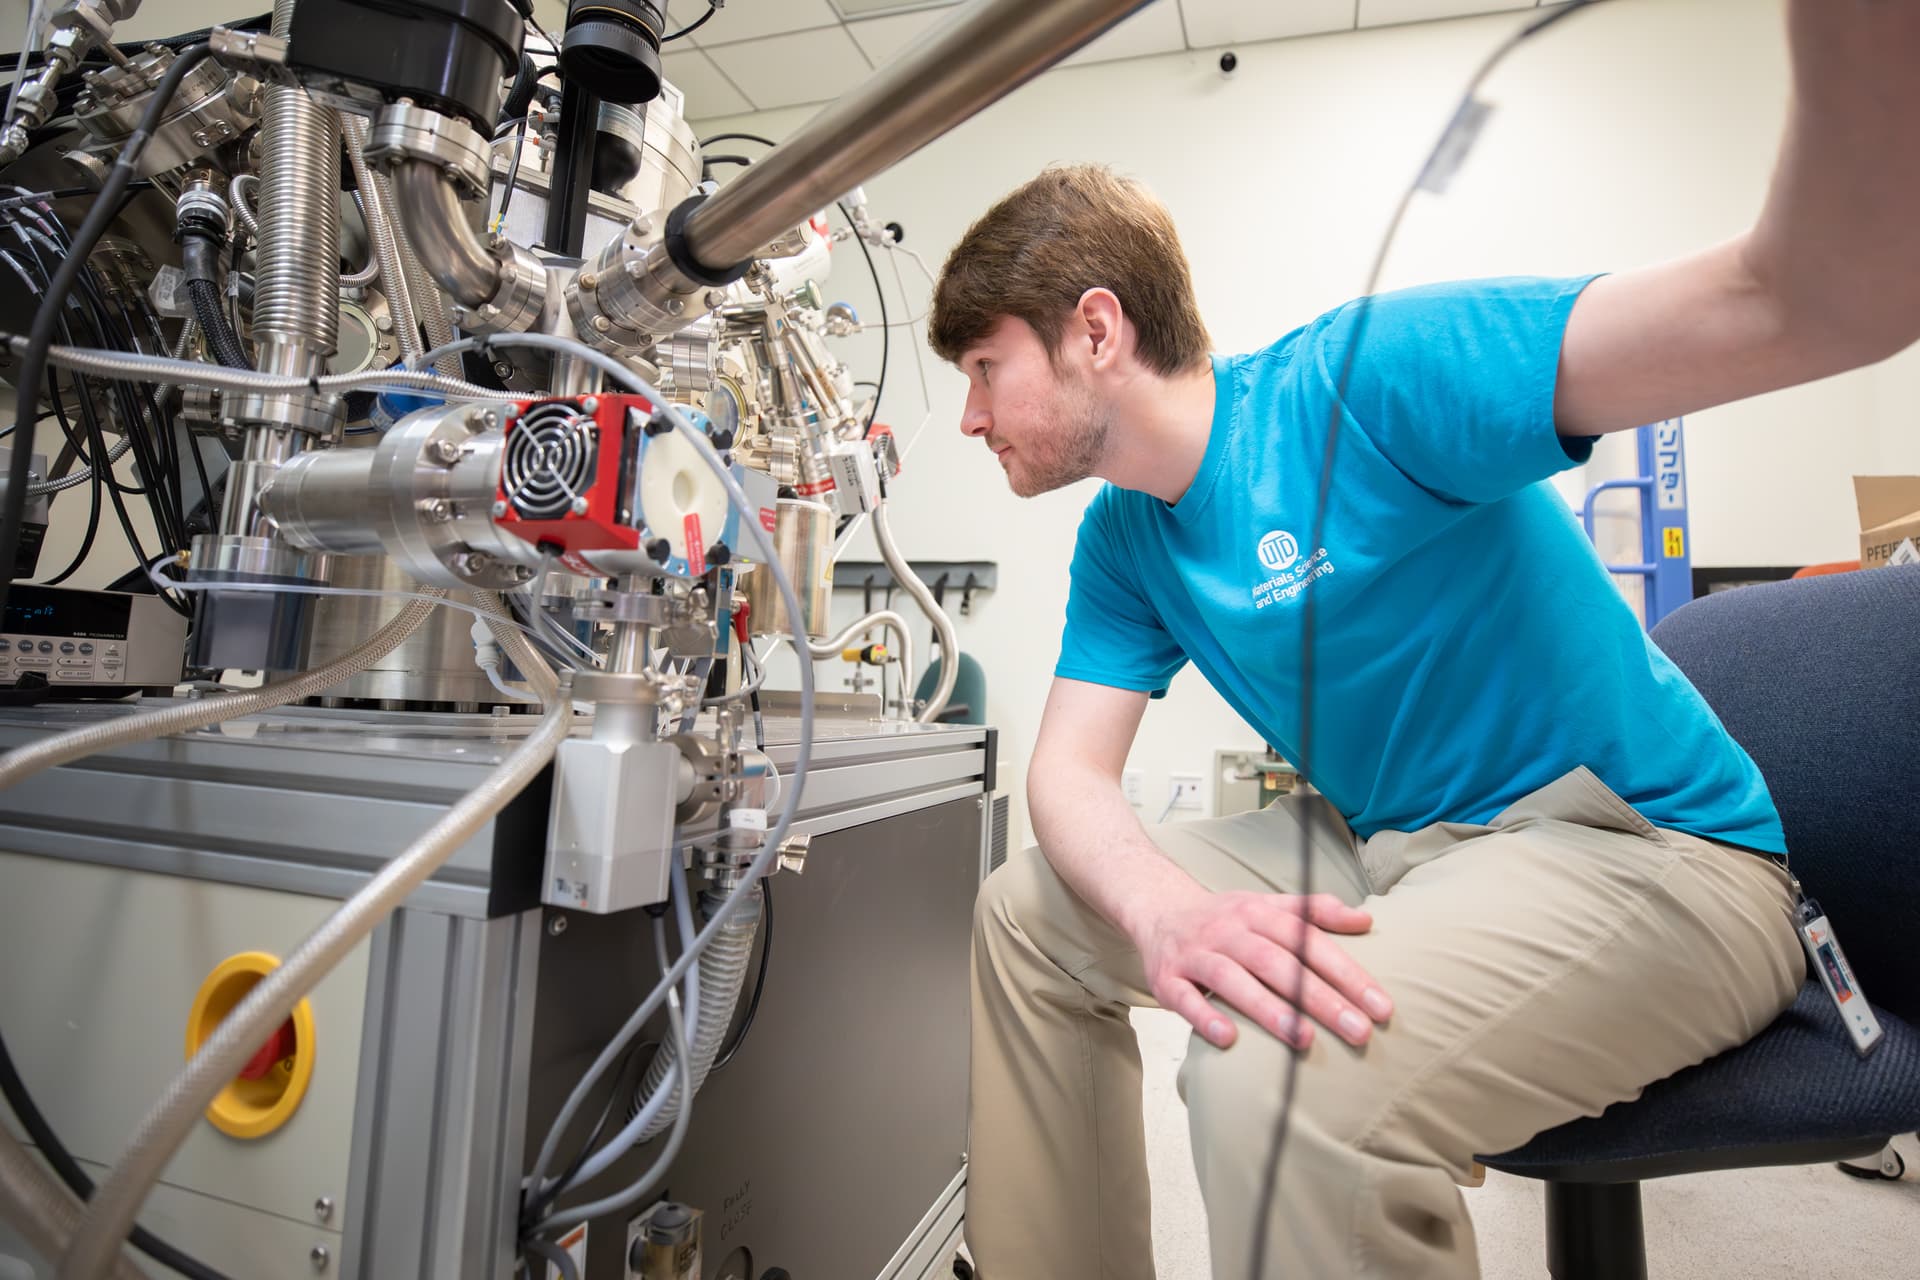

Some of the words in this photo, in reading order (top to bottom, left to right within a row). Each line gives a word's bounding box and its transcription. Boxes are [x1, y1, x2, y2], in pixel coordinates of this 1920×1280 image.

[1261, 533, 1296, 566] UTD
[1294, 546, 1329, 578] Science
[1866, 537, 1920, 562] PFEIF
[1255, 592, 1273, 609] and
[1272, 560, 1336, 602] Engineering
